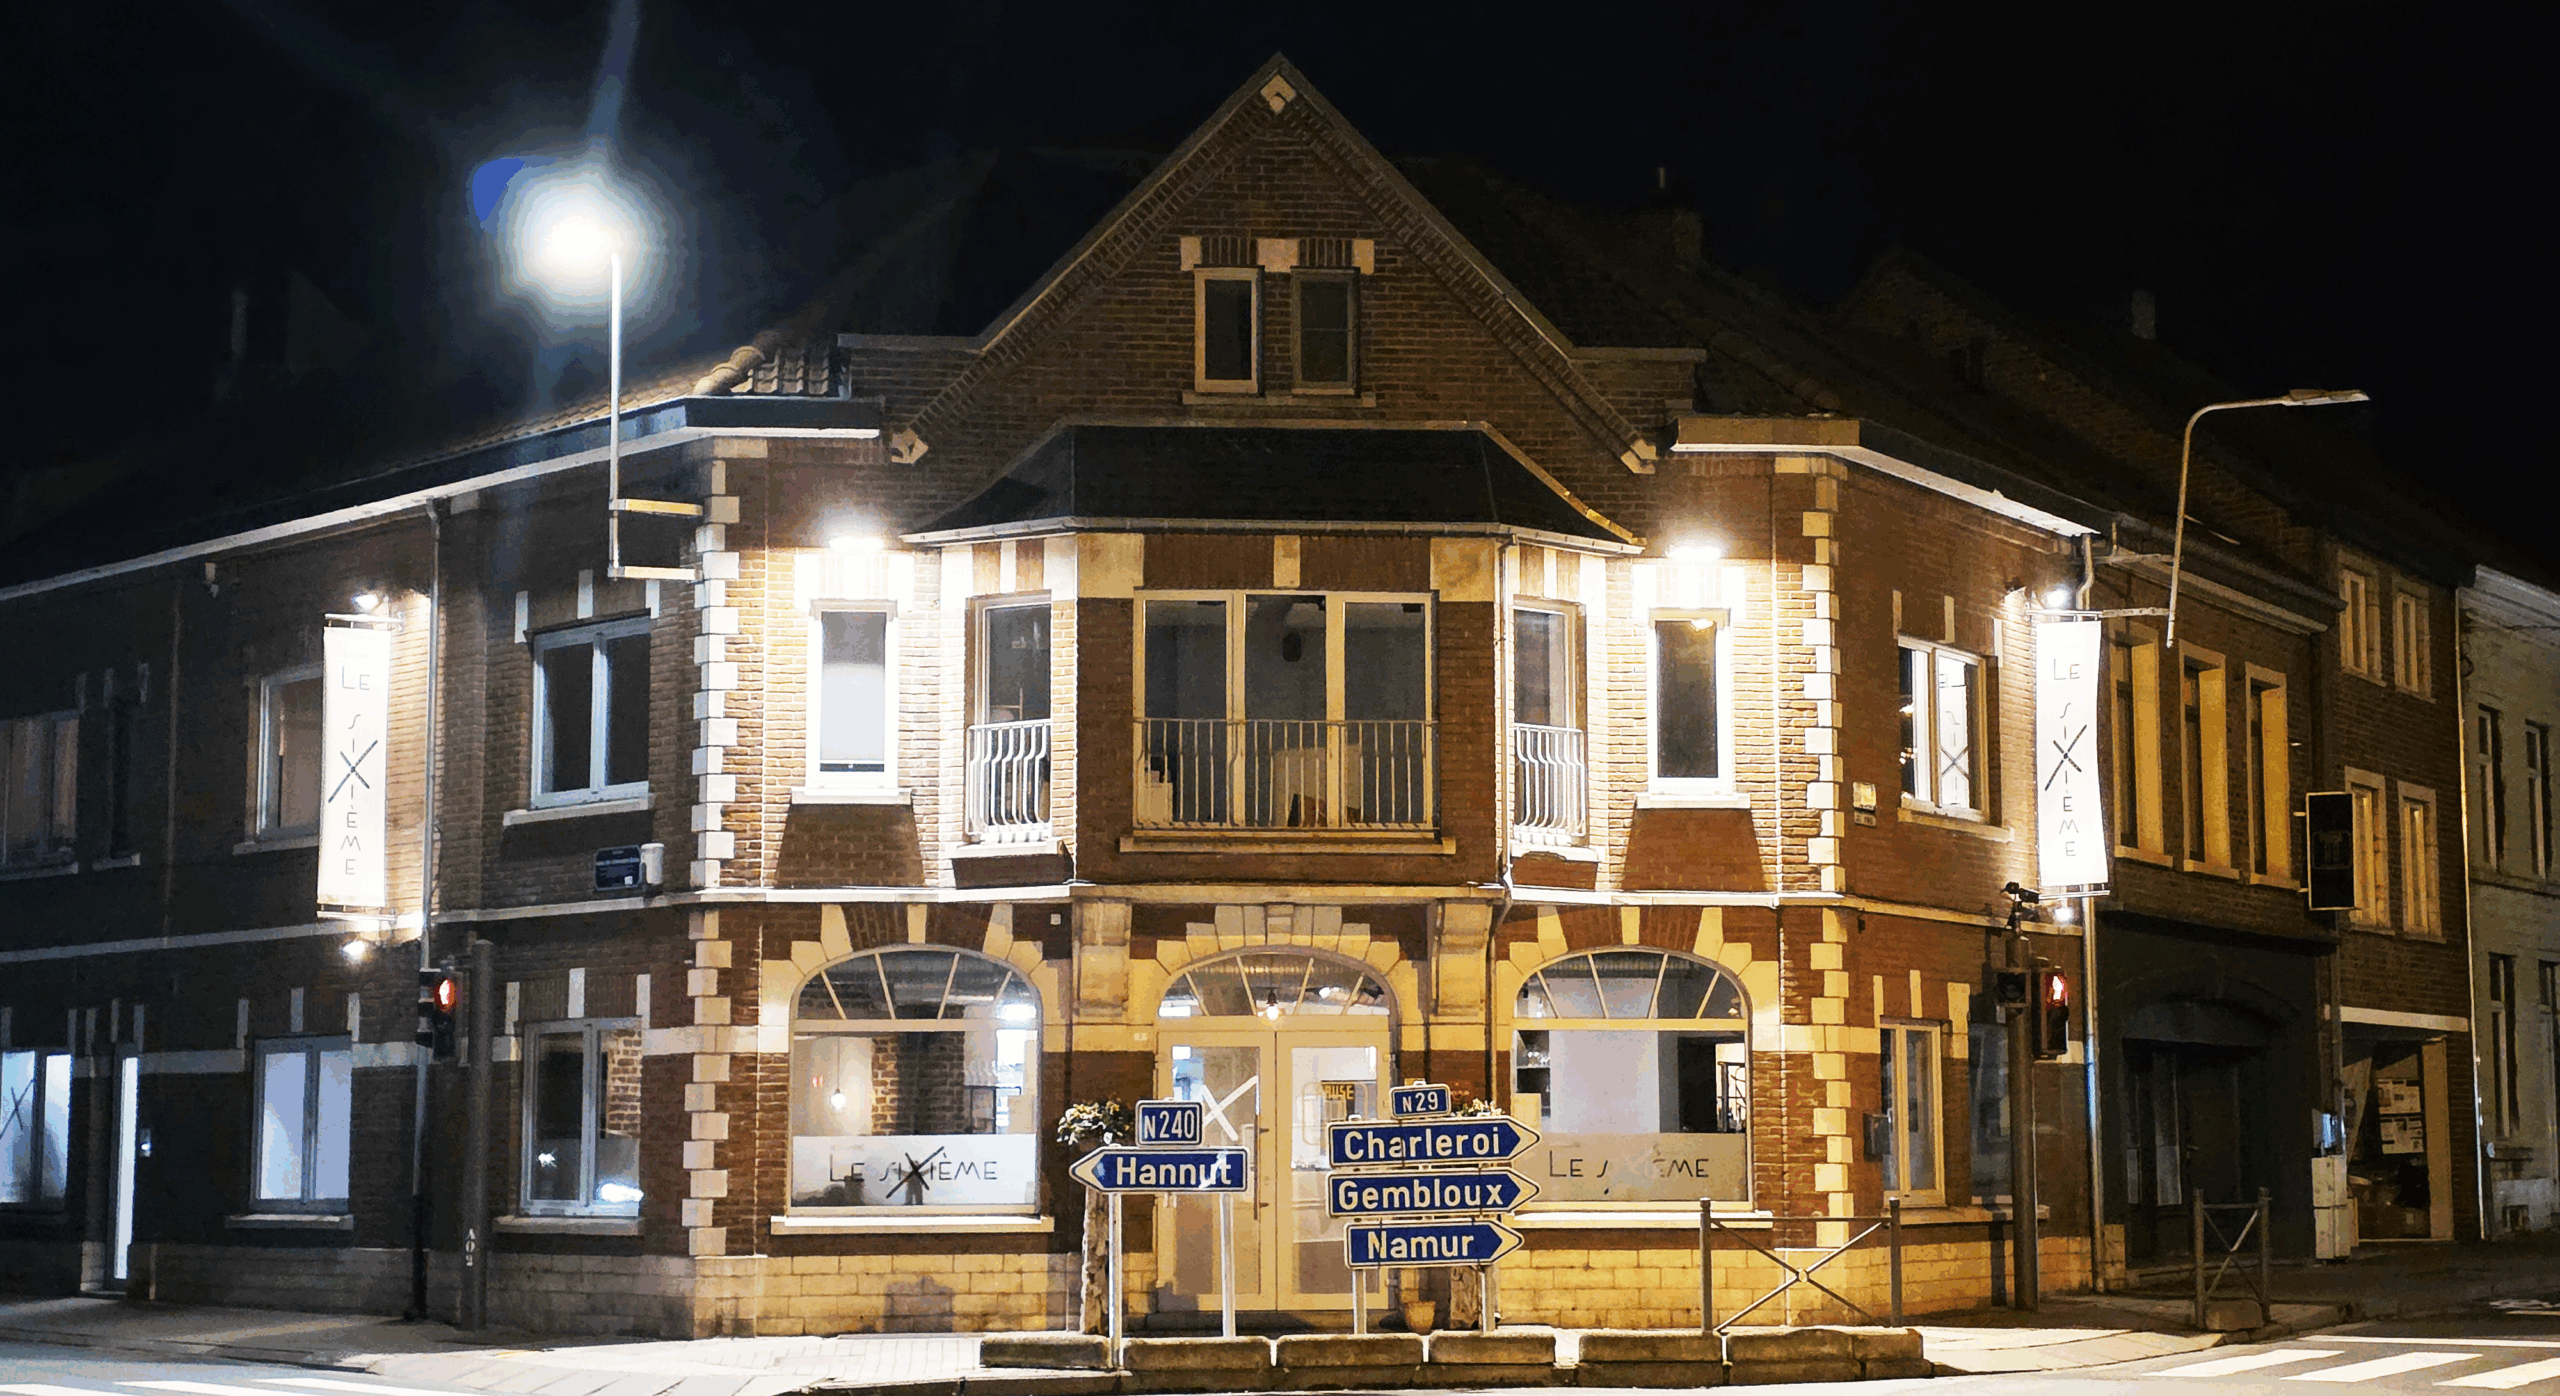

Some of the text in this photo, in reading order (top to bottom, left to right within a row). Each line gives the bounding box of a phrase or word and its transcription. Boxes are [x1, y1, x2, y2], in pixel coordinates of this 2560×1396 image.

[341, 664, 371, 691] LE
[2052, 657, 2081, 681] LE
[1402, 1091, 1439, 1113] N29
[1144, 1110, 1195, 1139] N240
[1344, 1127, 1499, 1161] Charleroi
[829, 1153, 865, 1183] LE
[1116, 1156, 1232, 1185] Hannut
[1549, 1150, 1584, 1178] LE
[1338, 1179, 1504, 1210] Gembloux
[1367, 1230, 1474, 1260] Namur
